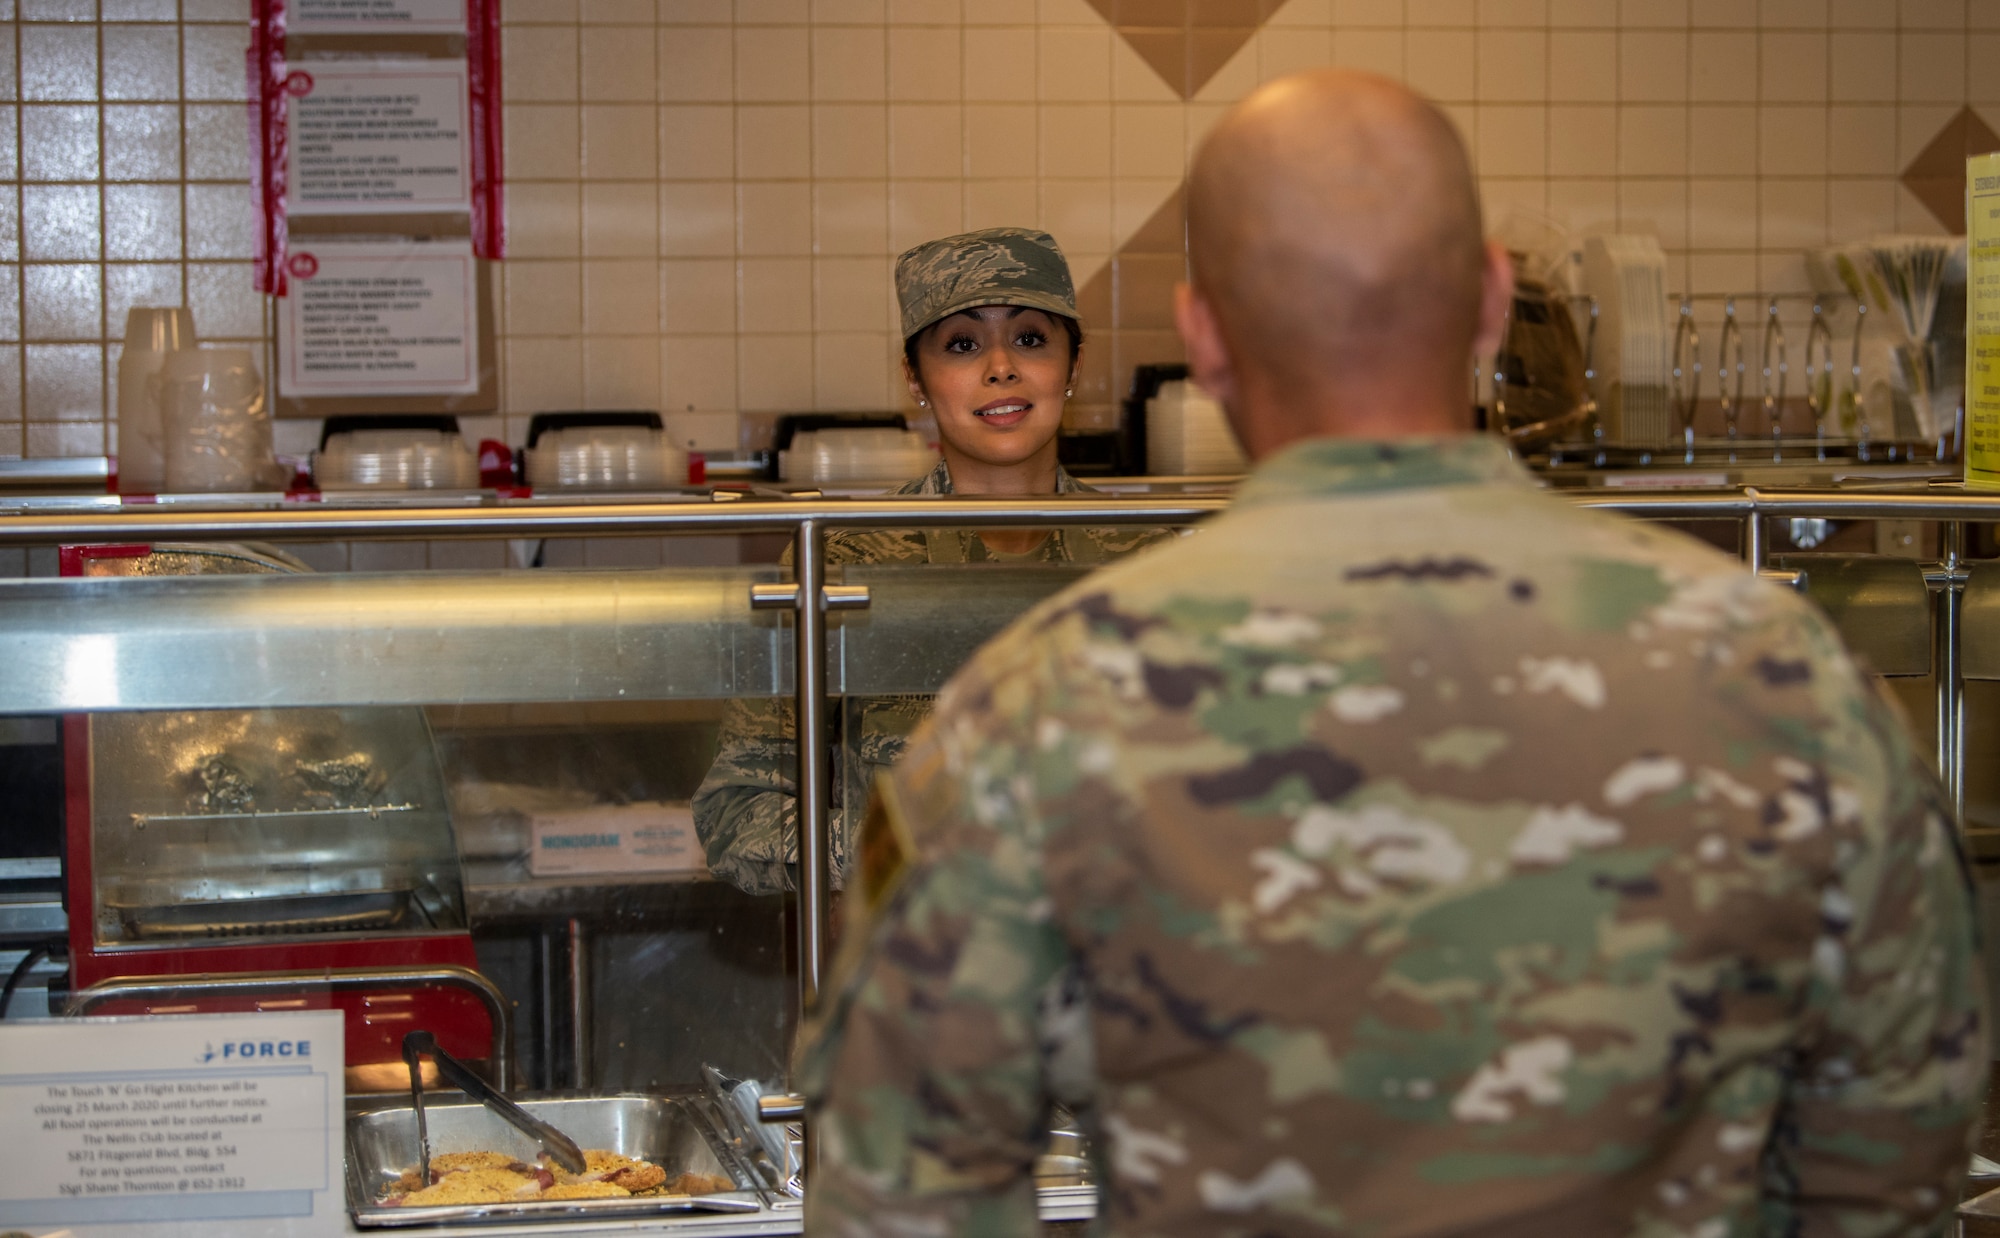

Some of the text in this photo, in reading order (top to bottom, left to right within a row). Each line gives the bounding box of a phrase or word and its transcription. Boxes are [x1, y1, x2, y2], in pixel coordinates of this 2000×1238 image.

[541, 833, 620, 849] MONOGRAM
[223, 1040, 311, 1058] FORCE
[47, 1086, 68, 1098] The
[71, 1085, 104, 1097] Touch
[125, 1083, 141, 1095] Go
[145, 1082, 175, 1097] Flight
[178, 1081, 219, 1094] Kitchen
[222, 1080, 241, 1092] will
[244, 1080, 258, 1091] be
[34, 1103, 72, 1116] closing
[76, 1102, 89, 1113] 25
[92, 1101, 129, 1113] March
[132, 1100, 160, 1111] 2020
[162, 1099, 187, 1110] until
[190, 1098, 229, 1109] further
[42, 1112, 263, 1130] All food operations will be conducted at
[83, 1130, 222, 1145] The Nellis Club located at
[68, 1150, 95, 1161] 5871
[99, 1148, 152, 1161] Fitzgerald
[80, 1166, 97, 1178] For
[101, 1167, 120, 1180] any
[184, 1162, 225, 1174] contact
[59, 1183, 82, 1197] SSgt
[85, 1182, 119, 1194] Shane
[122, 1180, 175, 1192] Thornton
[178, 1178, 189, 1191] @
